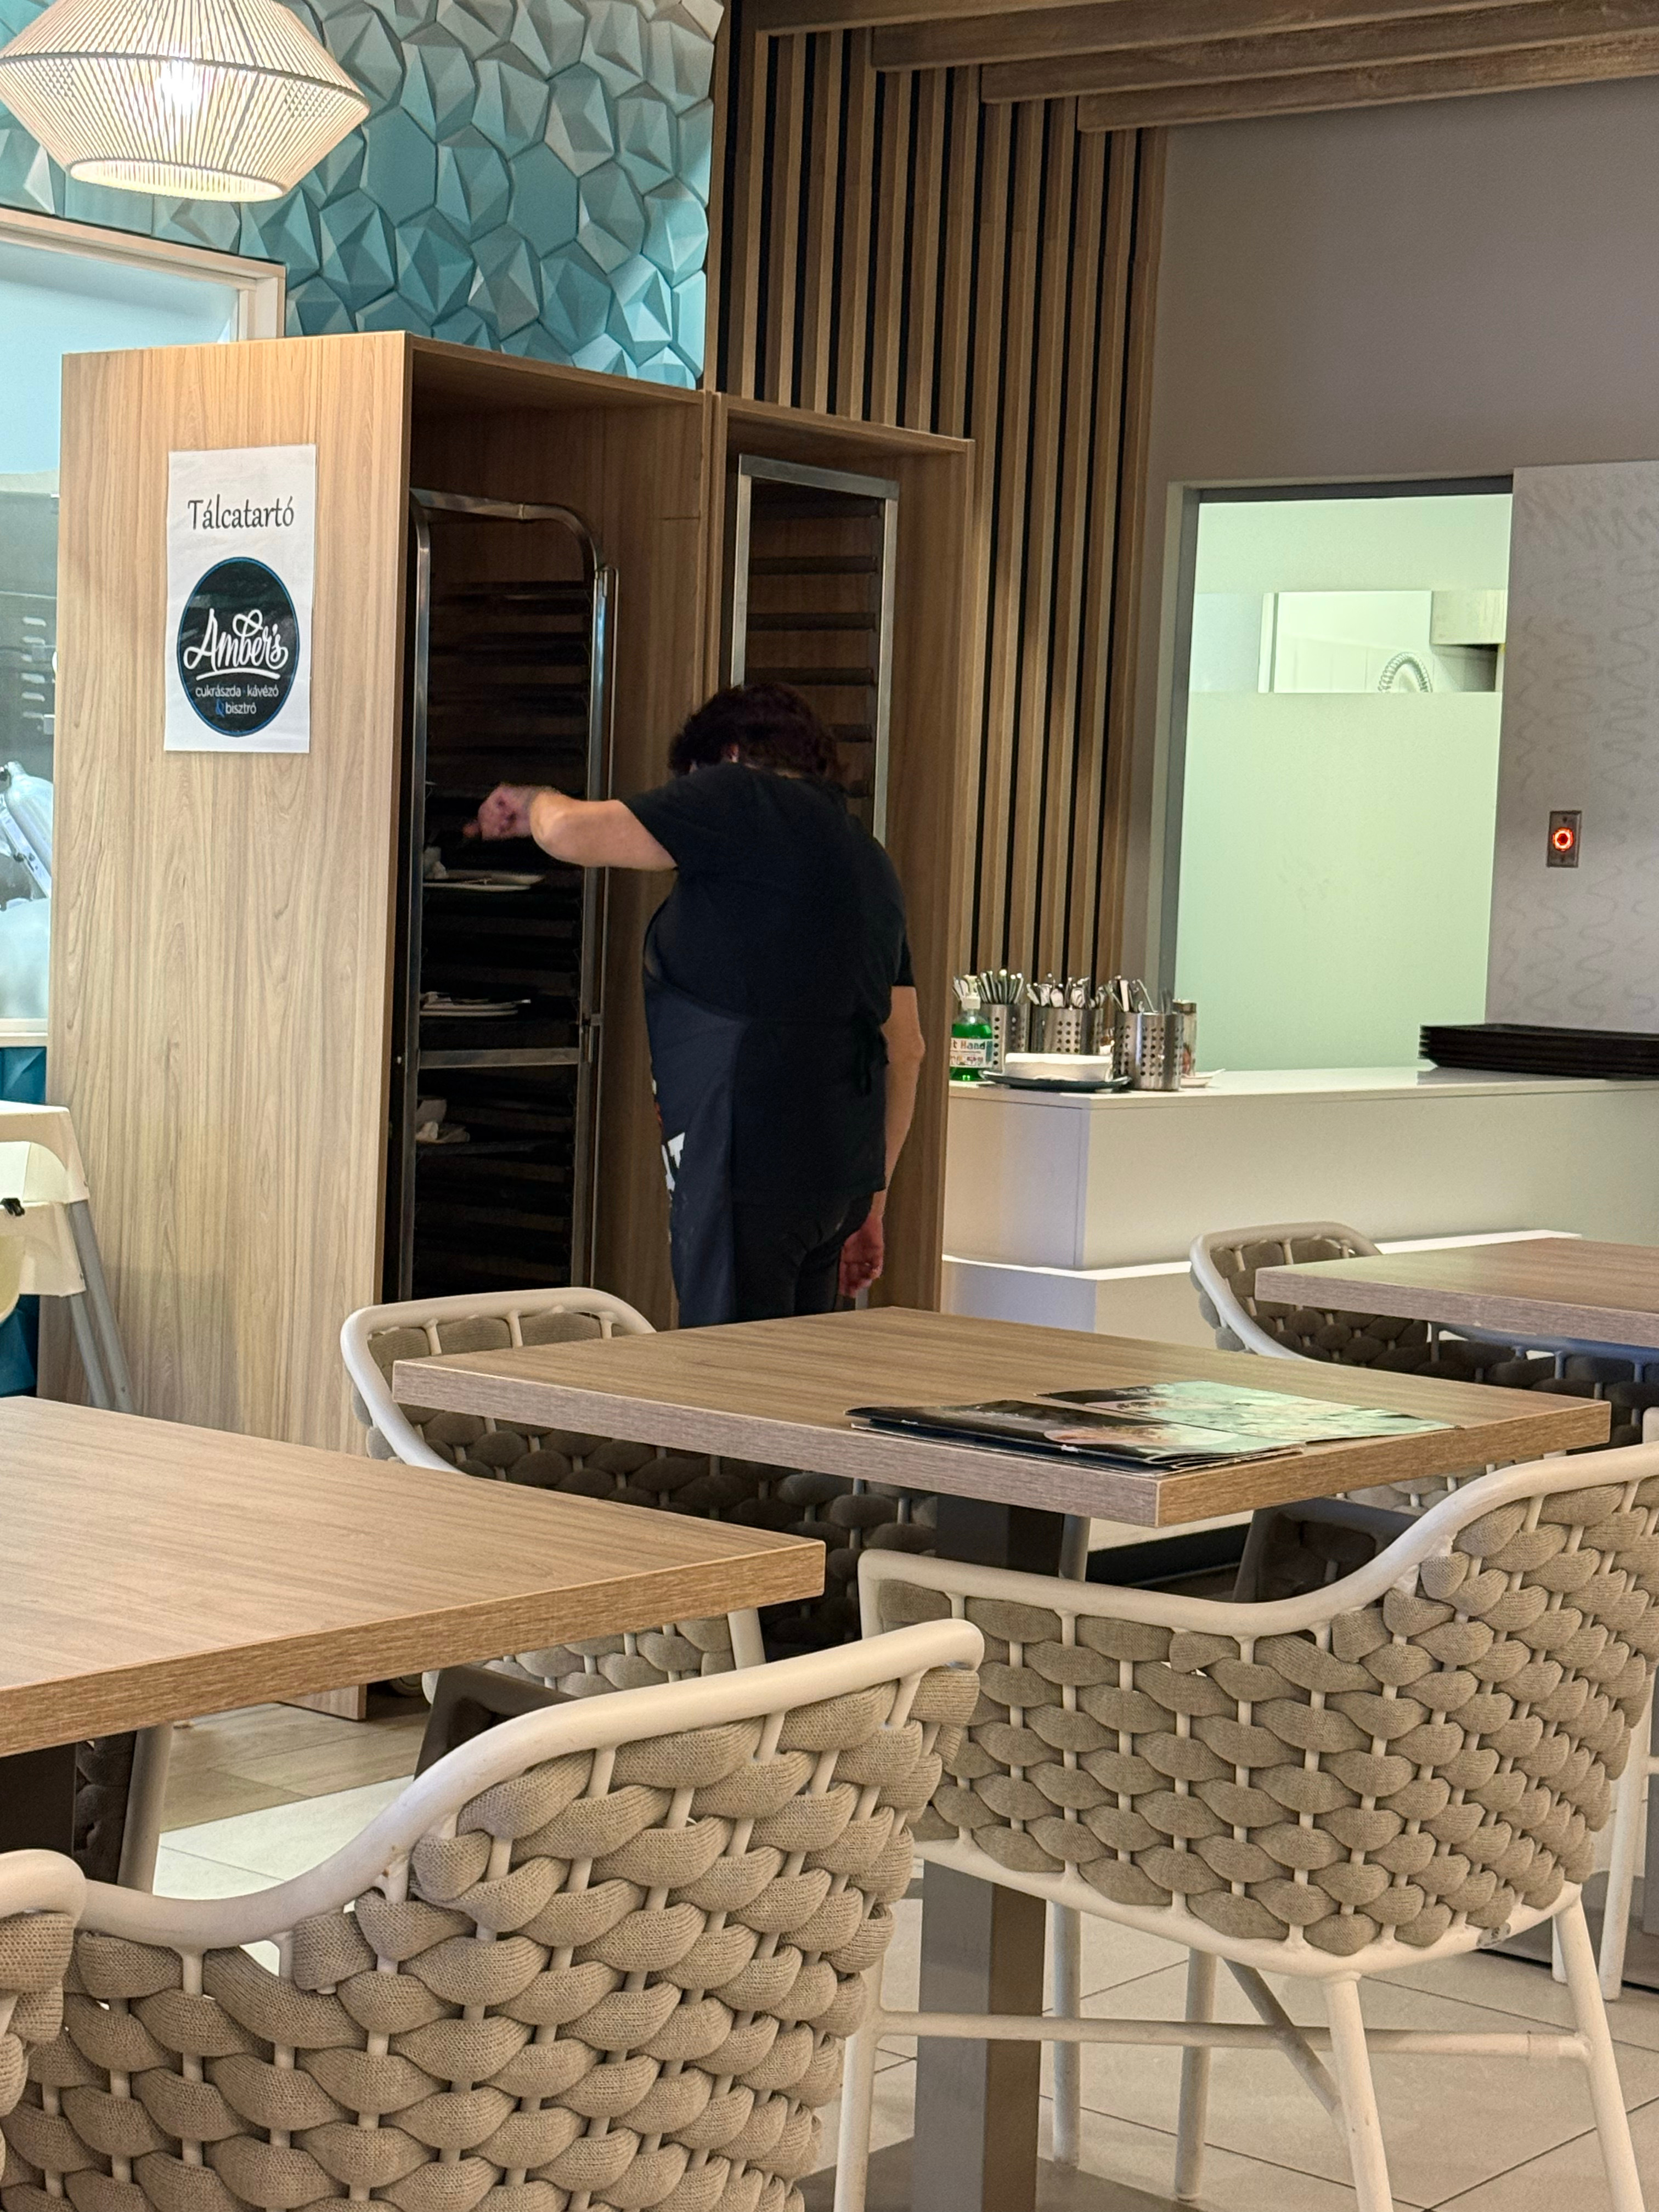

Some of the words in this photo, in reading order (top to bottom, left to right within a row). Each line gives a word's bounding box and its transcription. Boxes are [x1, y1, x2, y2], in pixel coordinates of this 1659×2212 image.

[187, 493, 295, 530] Tálcatartó
[183, 608, 289, 673] Amber's
[195, 684, 242, 697] cukrászda
[247, 684, 279, 697] kávézó
[225, 702, 257, 714] bisztró
